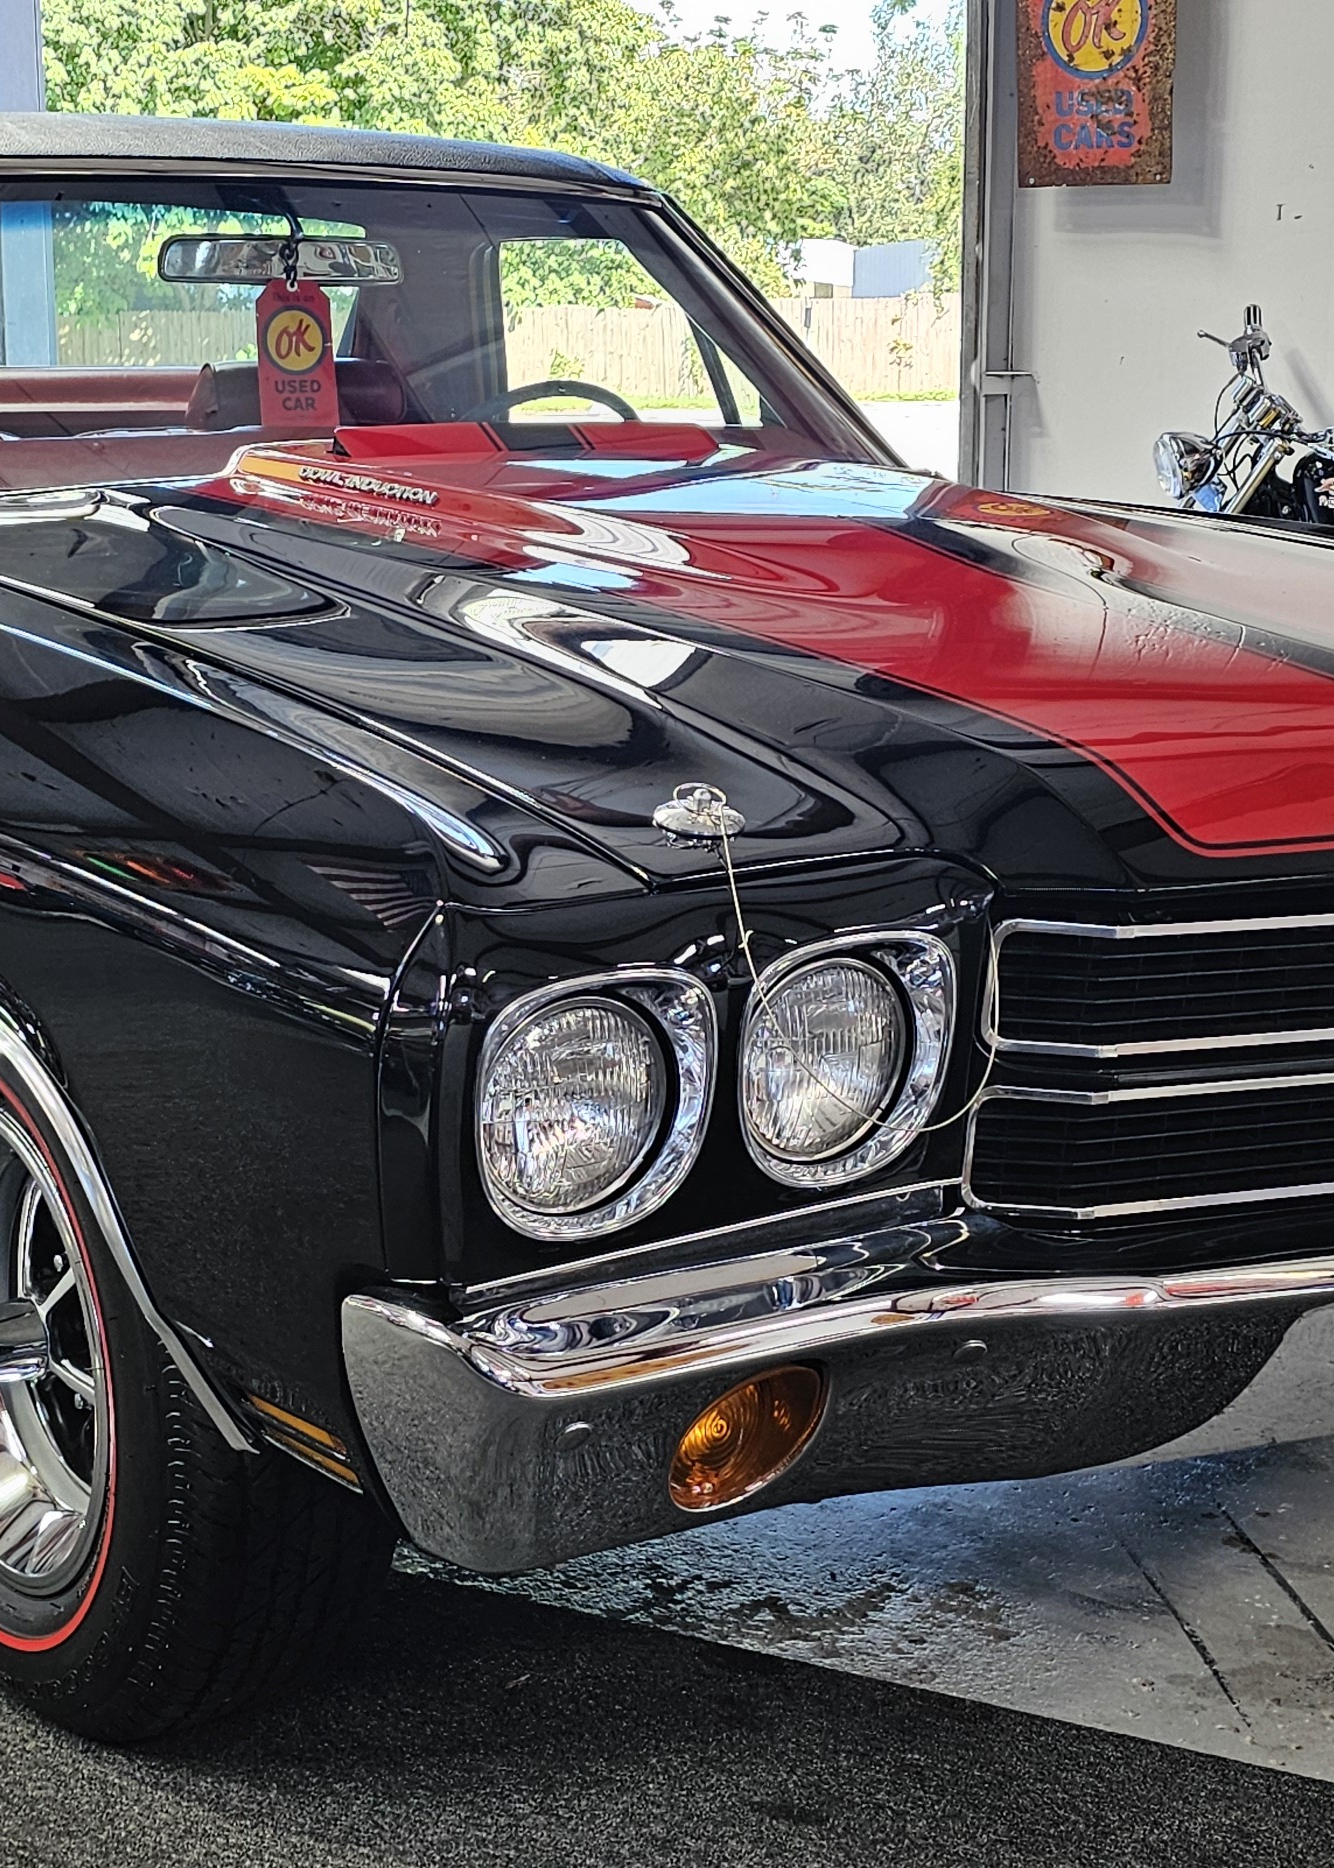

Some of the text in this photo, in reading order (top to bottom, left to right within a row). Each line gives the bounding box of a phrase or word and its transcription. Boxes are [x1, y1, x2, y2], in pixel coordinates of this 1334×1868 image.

[1061, 0, 1127, 53] OK
[1054, 88, 1135, 118] USED
[1053, 121, 1136, 150] CARS
[275, 318, 316, 360] OK
[274, 379, 322, 394] USED
[281, 396, 317, 412] CAR
